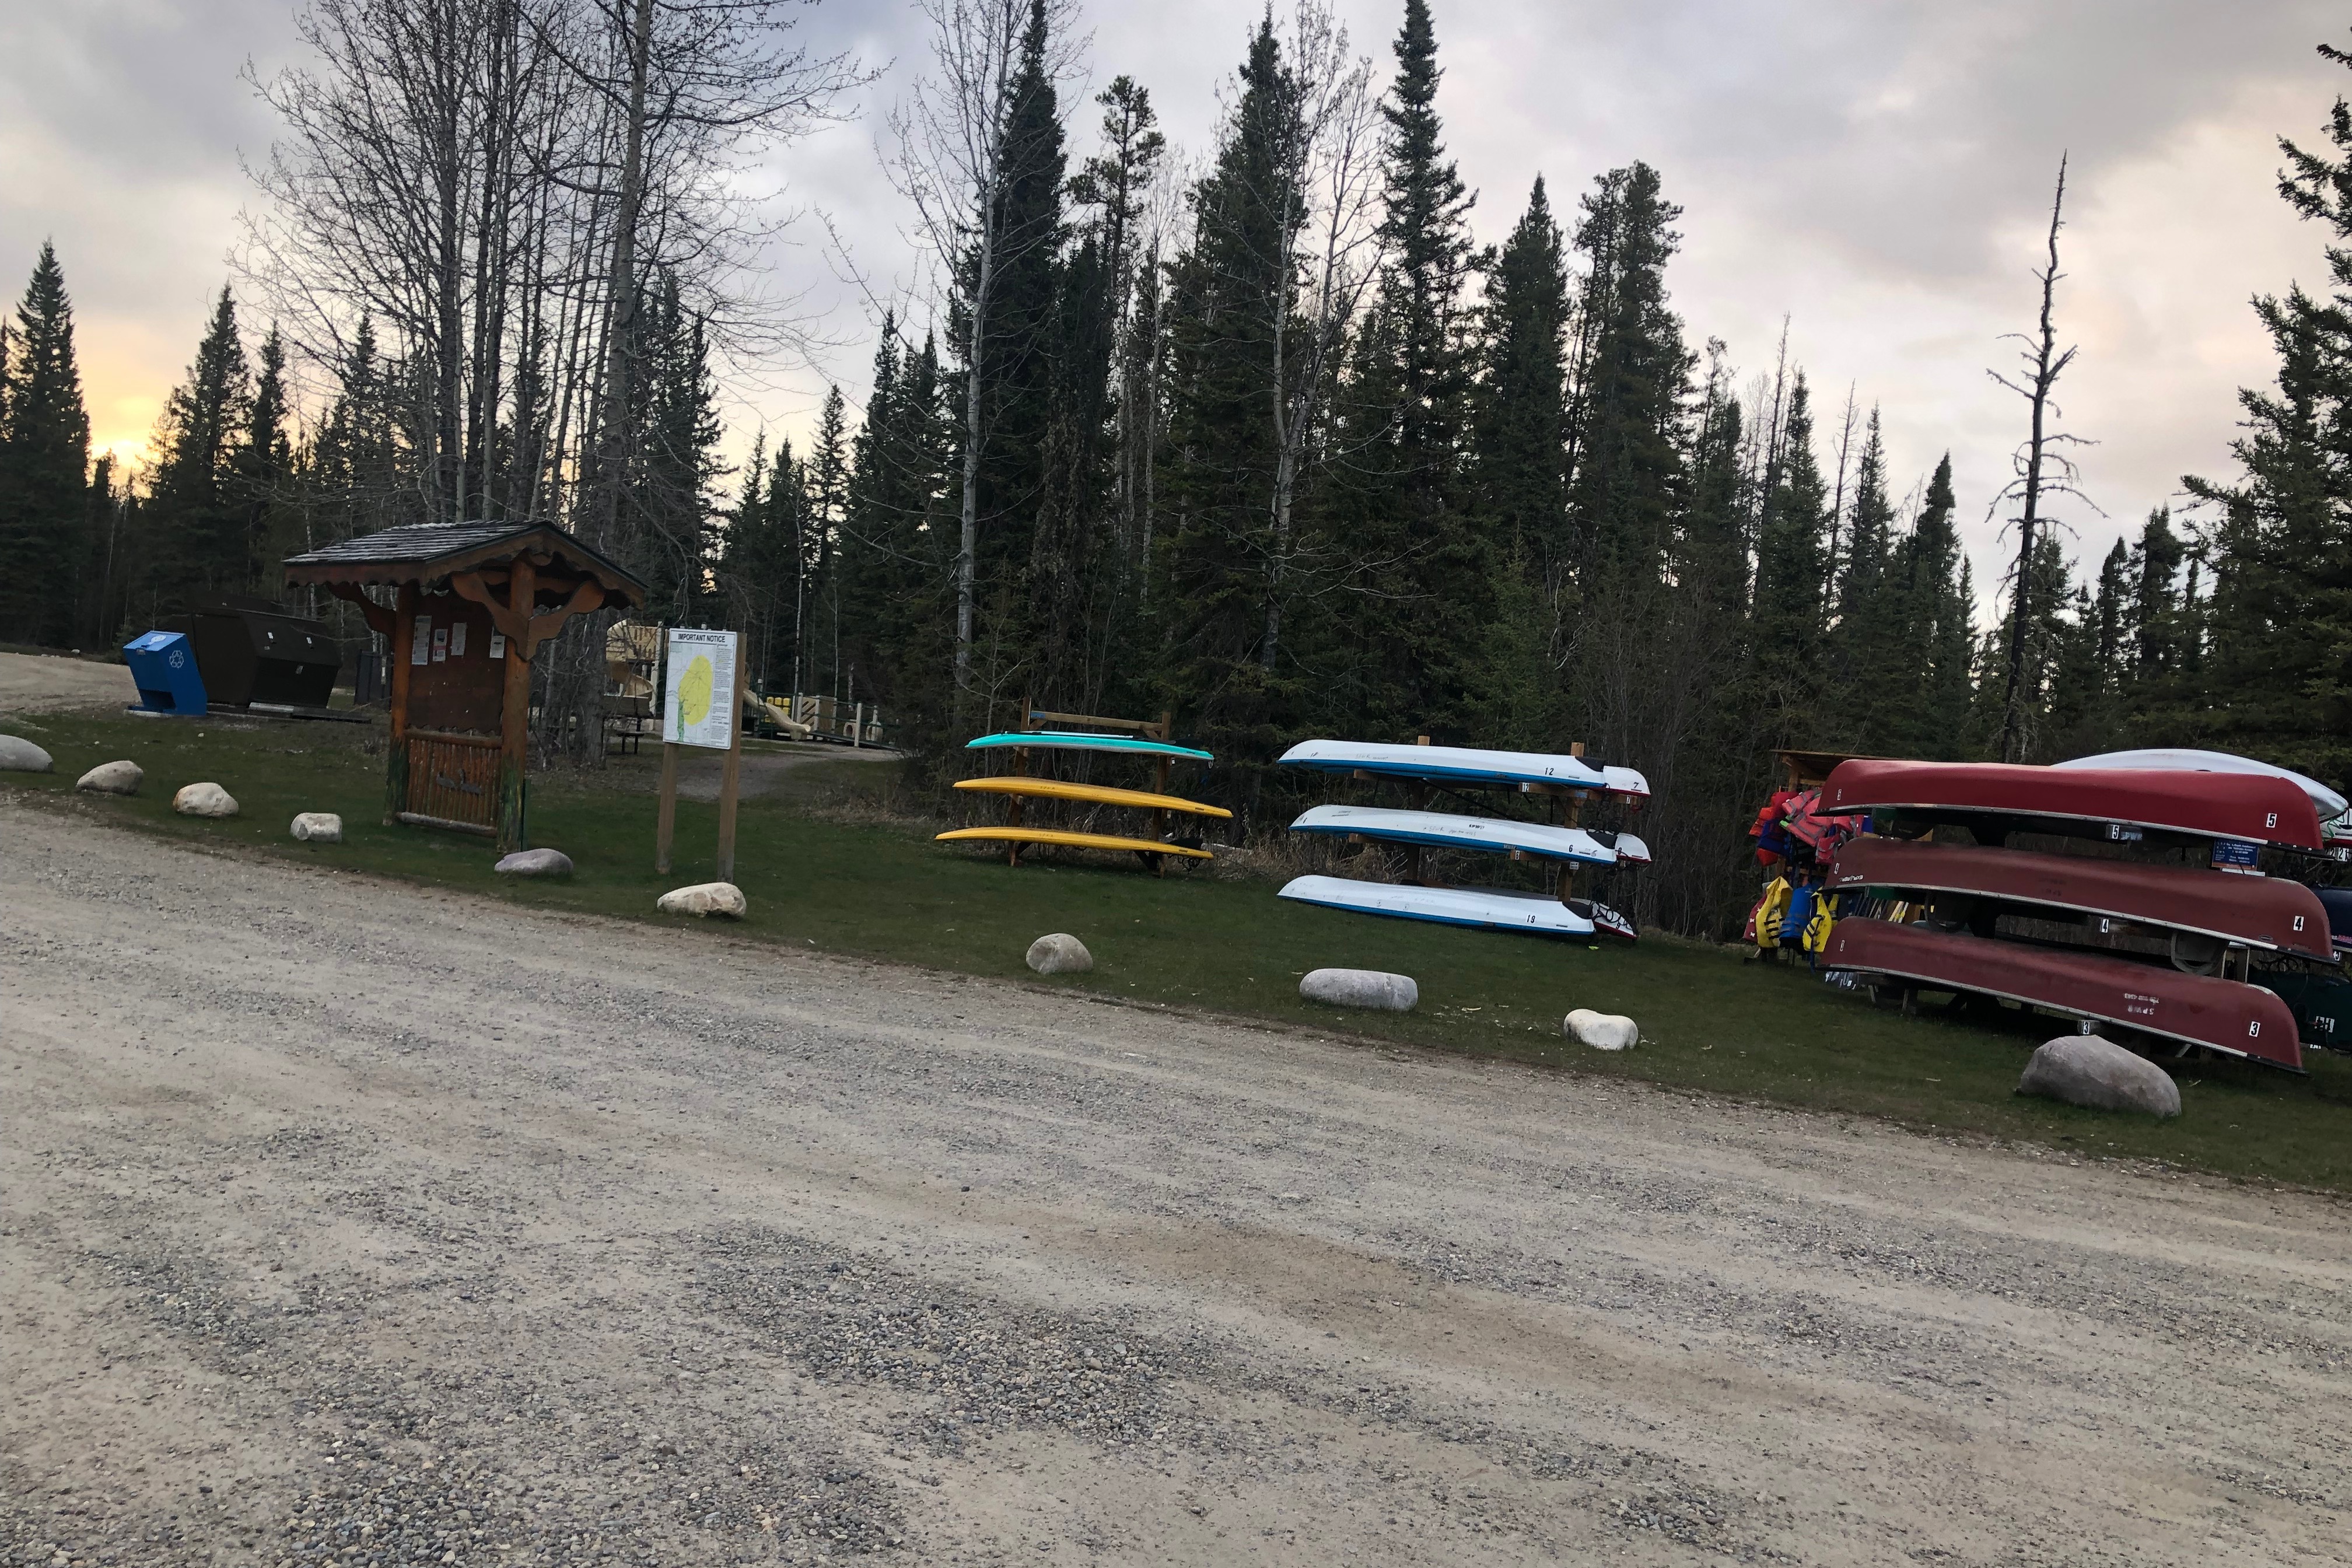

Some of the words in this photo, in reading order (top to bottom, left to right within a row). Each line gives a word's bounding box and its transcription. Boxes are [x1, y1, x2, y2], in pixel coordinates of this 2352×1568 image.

[678, 634, 706, 642] IMPORTANT
[1545, 767, 1554, 776] 12
[1523, 783, 1529, 792] 12
[2268, 814, 2276, 827] 5
[2113, 826, 2118, 838] 5
[1569, 844, 1573, 852] 6
[2103, 919, 2107, 932] 4
[2295, 917, 2301, 930] 4
[2084, 1021, 2088, 1034] 3
[2250, 1023, 2259, 1035] 3
